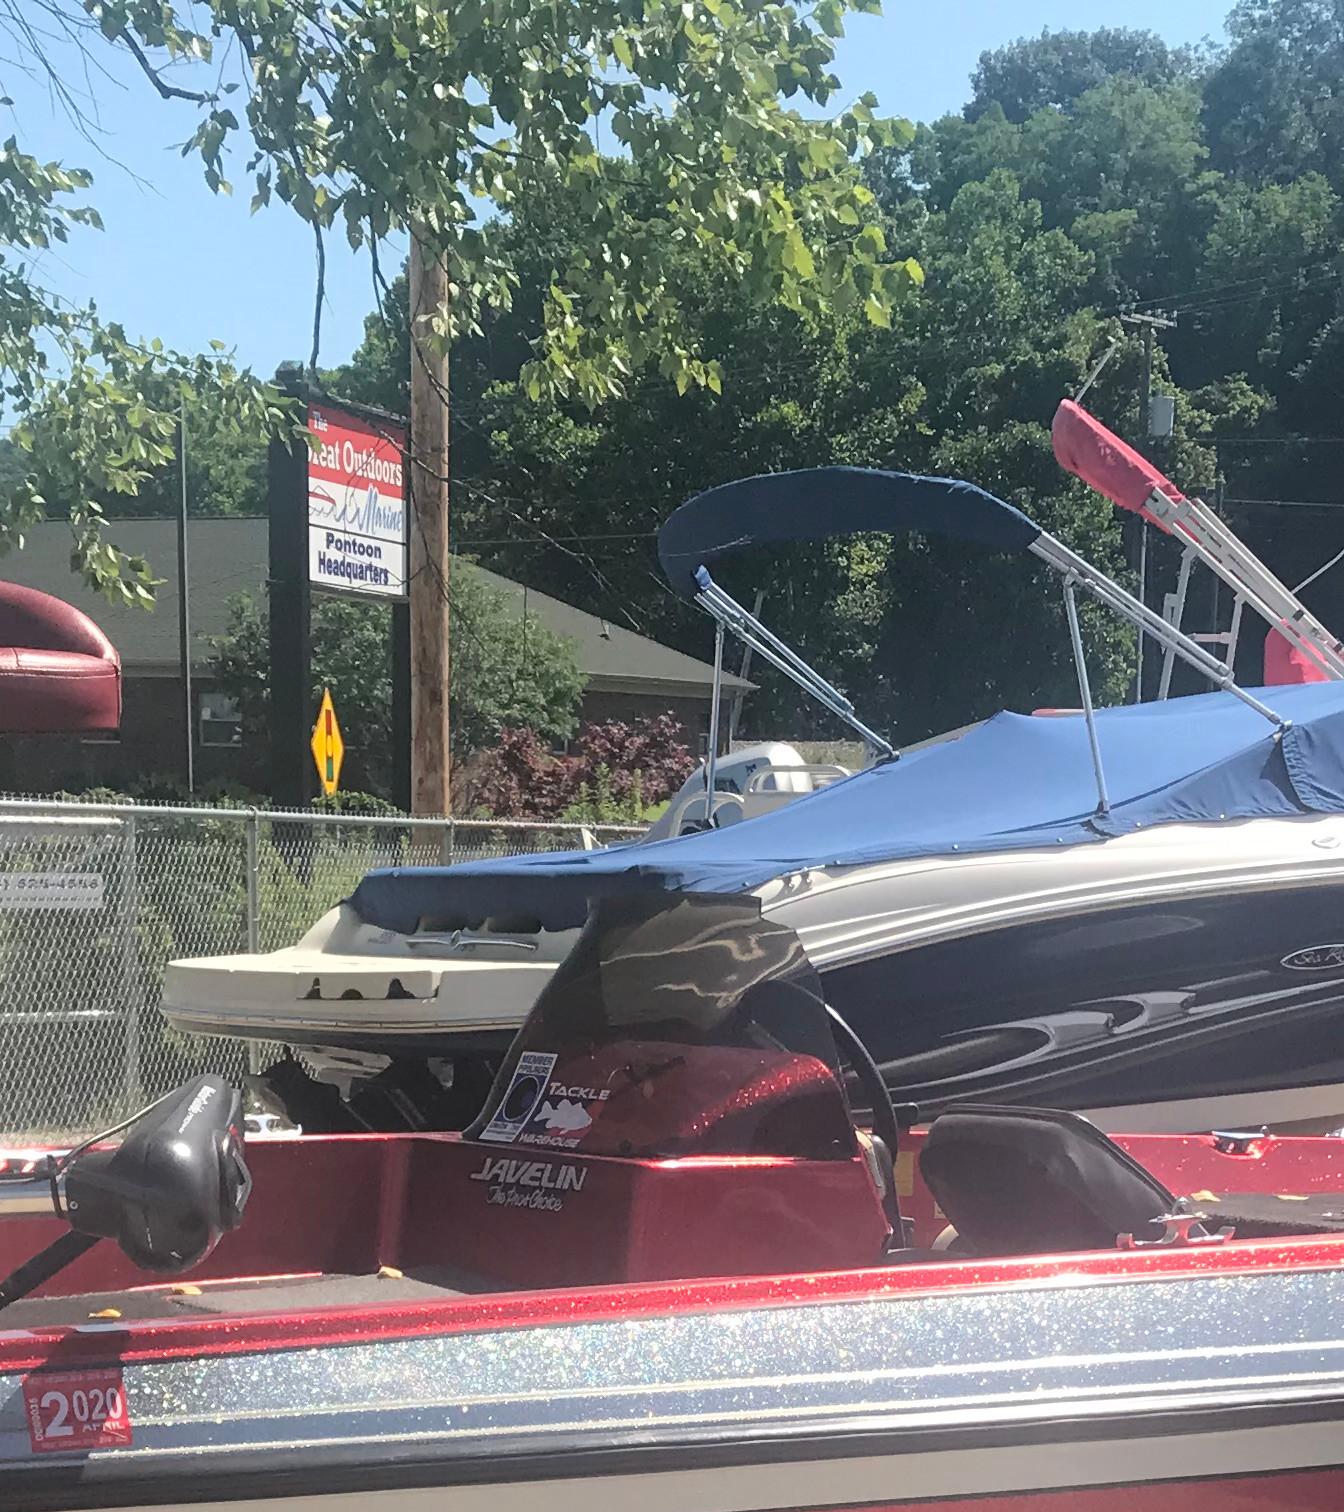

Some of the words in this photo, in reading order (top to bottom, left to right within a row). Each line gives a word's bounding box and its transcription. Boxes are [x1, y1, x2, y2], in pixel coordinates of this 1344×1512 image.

[312, 411, 328, 432] The
[343, 441, 403, 487] Outdoors
[357, 483, 402, 535] Marine
[326, 531, 382, 559] Pontoon
[318, 550, 389, 585] Headquarters
[550, 1082, 611, 1101] TACKLE
[517, 1132, 580, 1148] WAREHOUSE
[470, 1157, 588, 1191] JAVELIN
[40, 1387, 123, 1438] 2020
